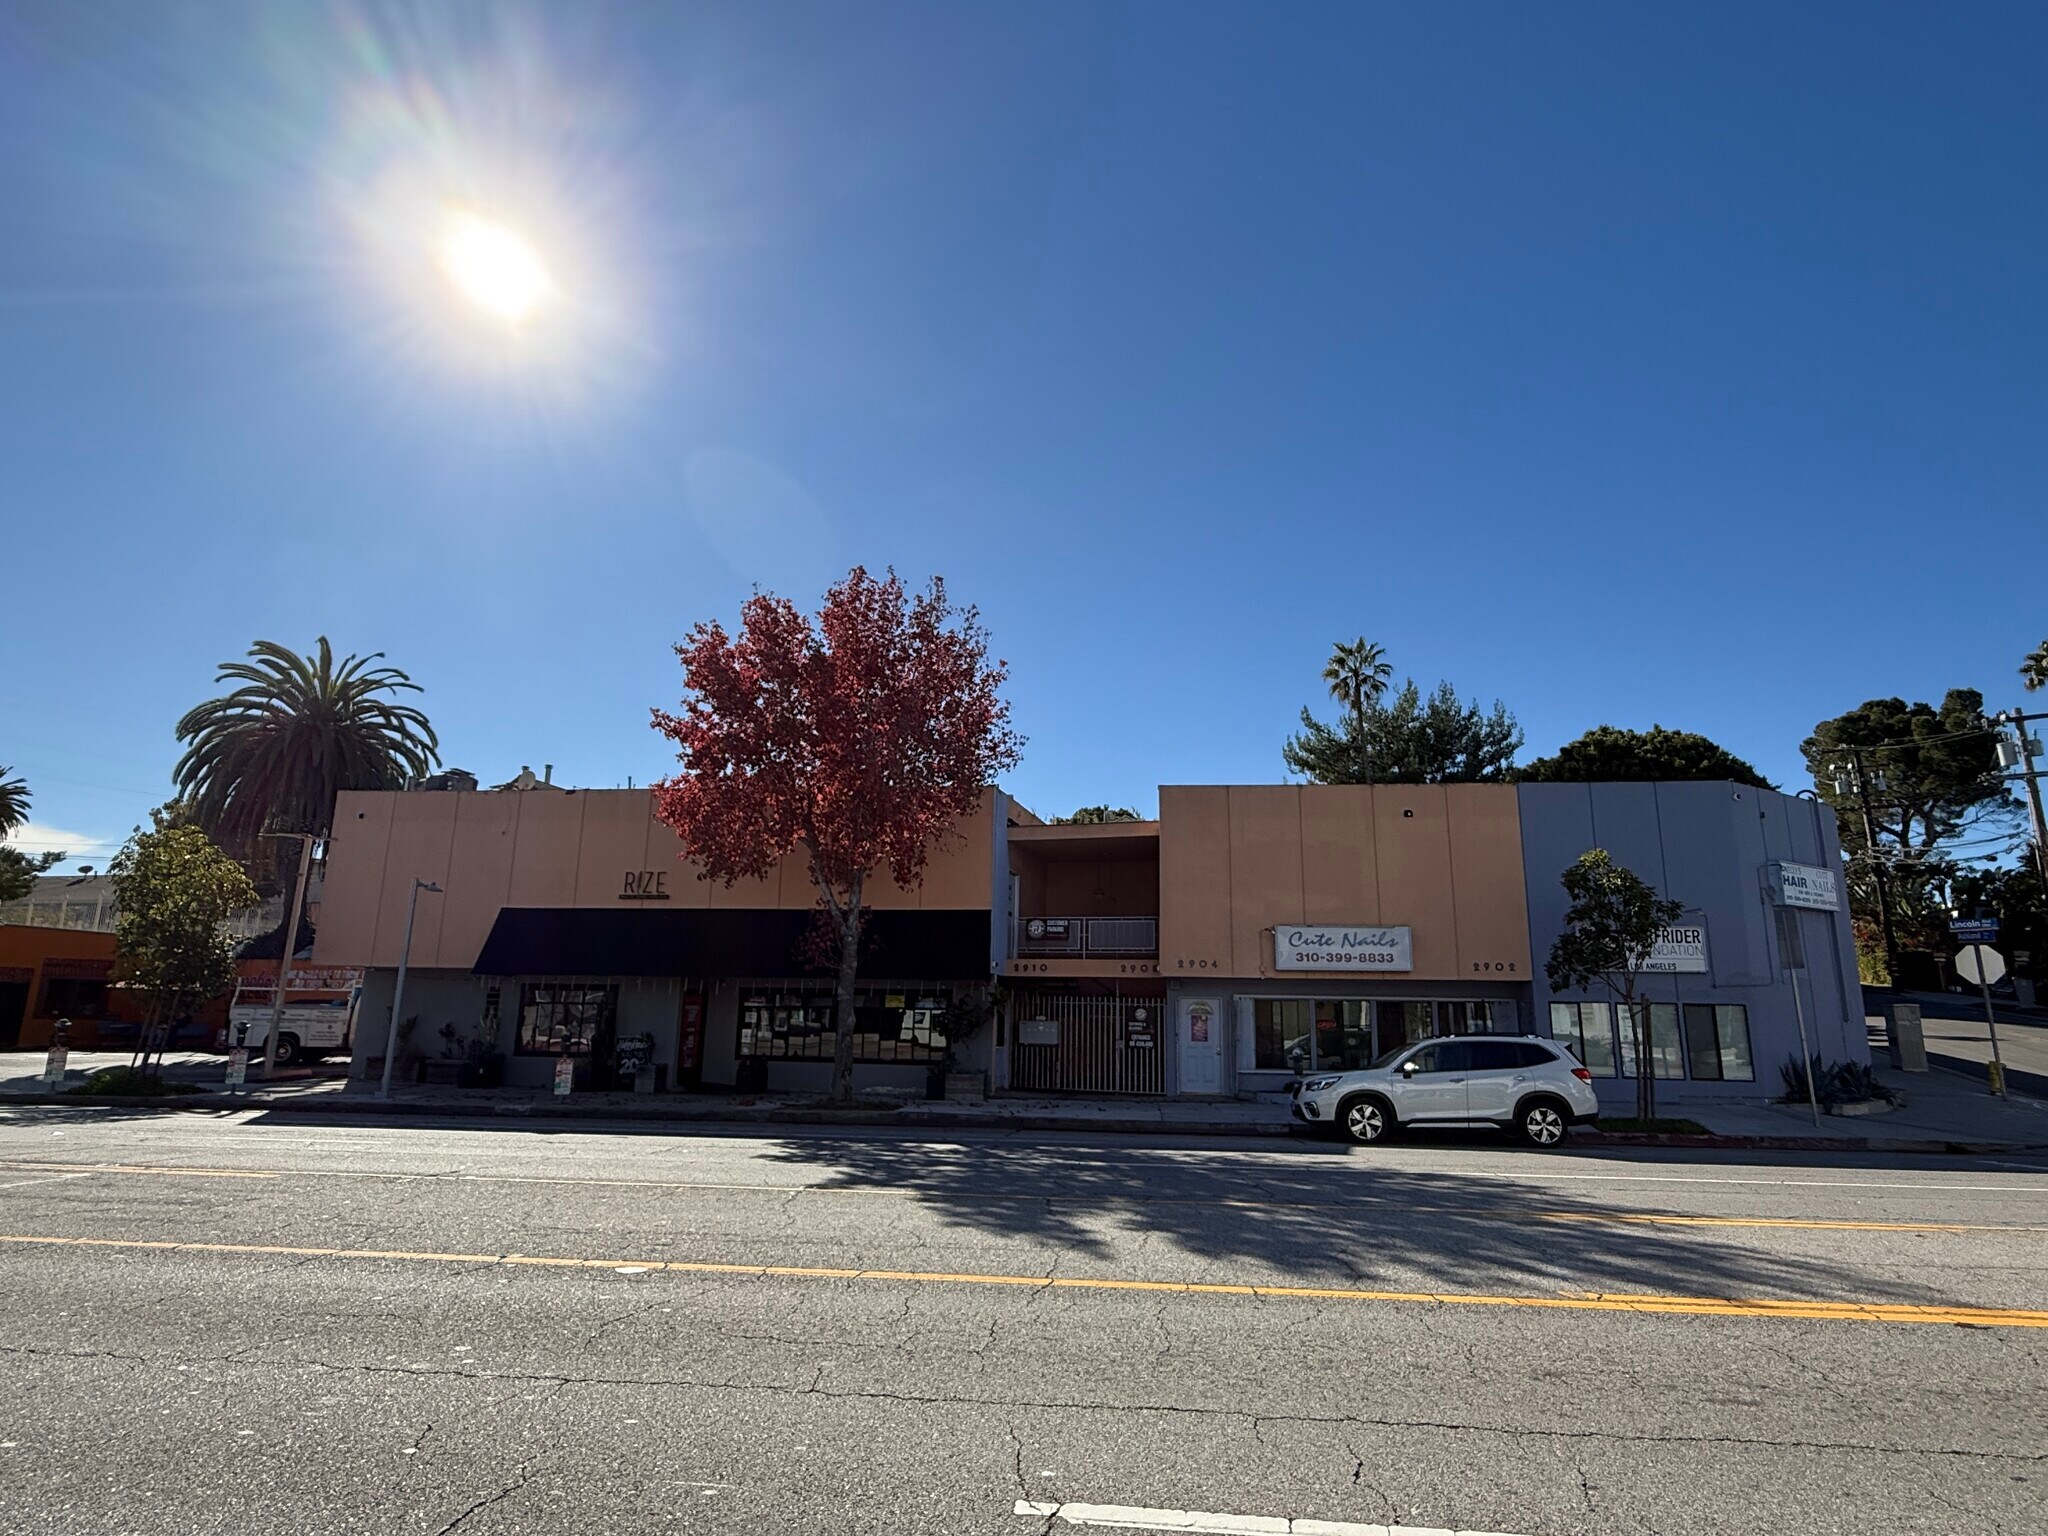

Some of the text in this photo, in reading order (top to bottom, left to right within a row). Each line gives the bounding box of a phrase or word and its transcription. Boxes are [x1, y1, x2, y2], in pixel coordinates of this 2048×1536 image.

[624, 871, 667, 893] RIZE
[1783, 875, 1808, 889] HAIR
[1812, 879, 1836, 893] NAILS
[1949, 919, 1981, 929] Lincoln
[1288, 931, 1399, 949] Cute Nails
[1651, 929, 1702, 944] FRIDER
[1651, 944, 1704, 956] NDATION
[1296, 952, 1395, 963] 310-399-8833
[1014, 963, 1048, 972] 2910
[1178, 959, 1217, 968] 2904
[1473, 962, 1516, 971] 2902
[1646, 962, 1677, 971] ANGELES
